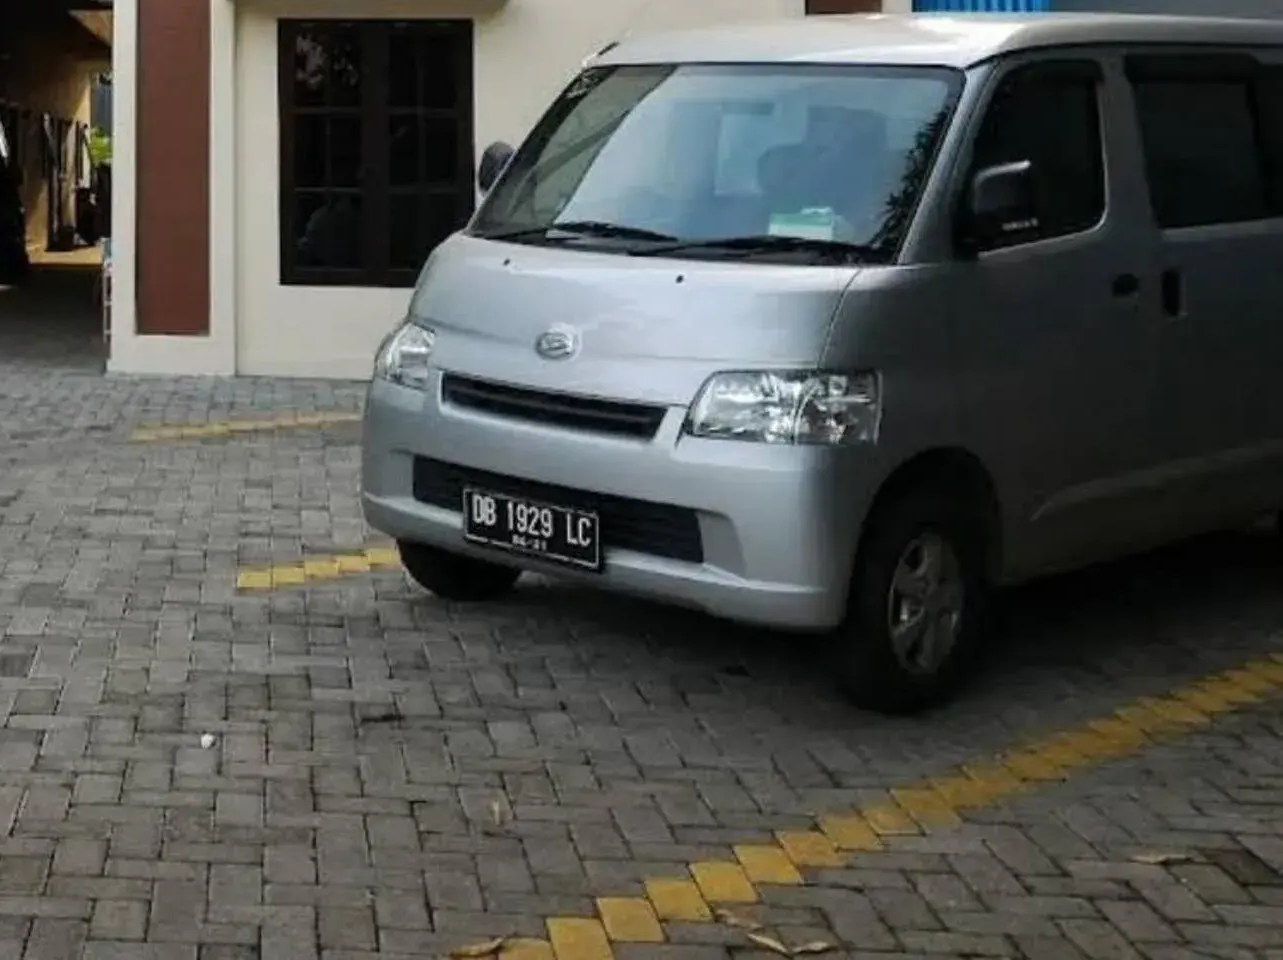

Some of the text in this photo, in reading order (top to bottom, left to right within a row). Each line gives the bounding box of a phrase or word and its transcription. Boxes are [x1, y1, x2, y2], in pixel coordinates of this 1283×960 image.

[472, 494, 497, 526] DB
[507, 500, 553, 539] 1929
[566, 512, 592, 547] LC
